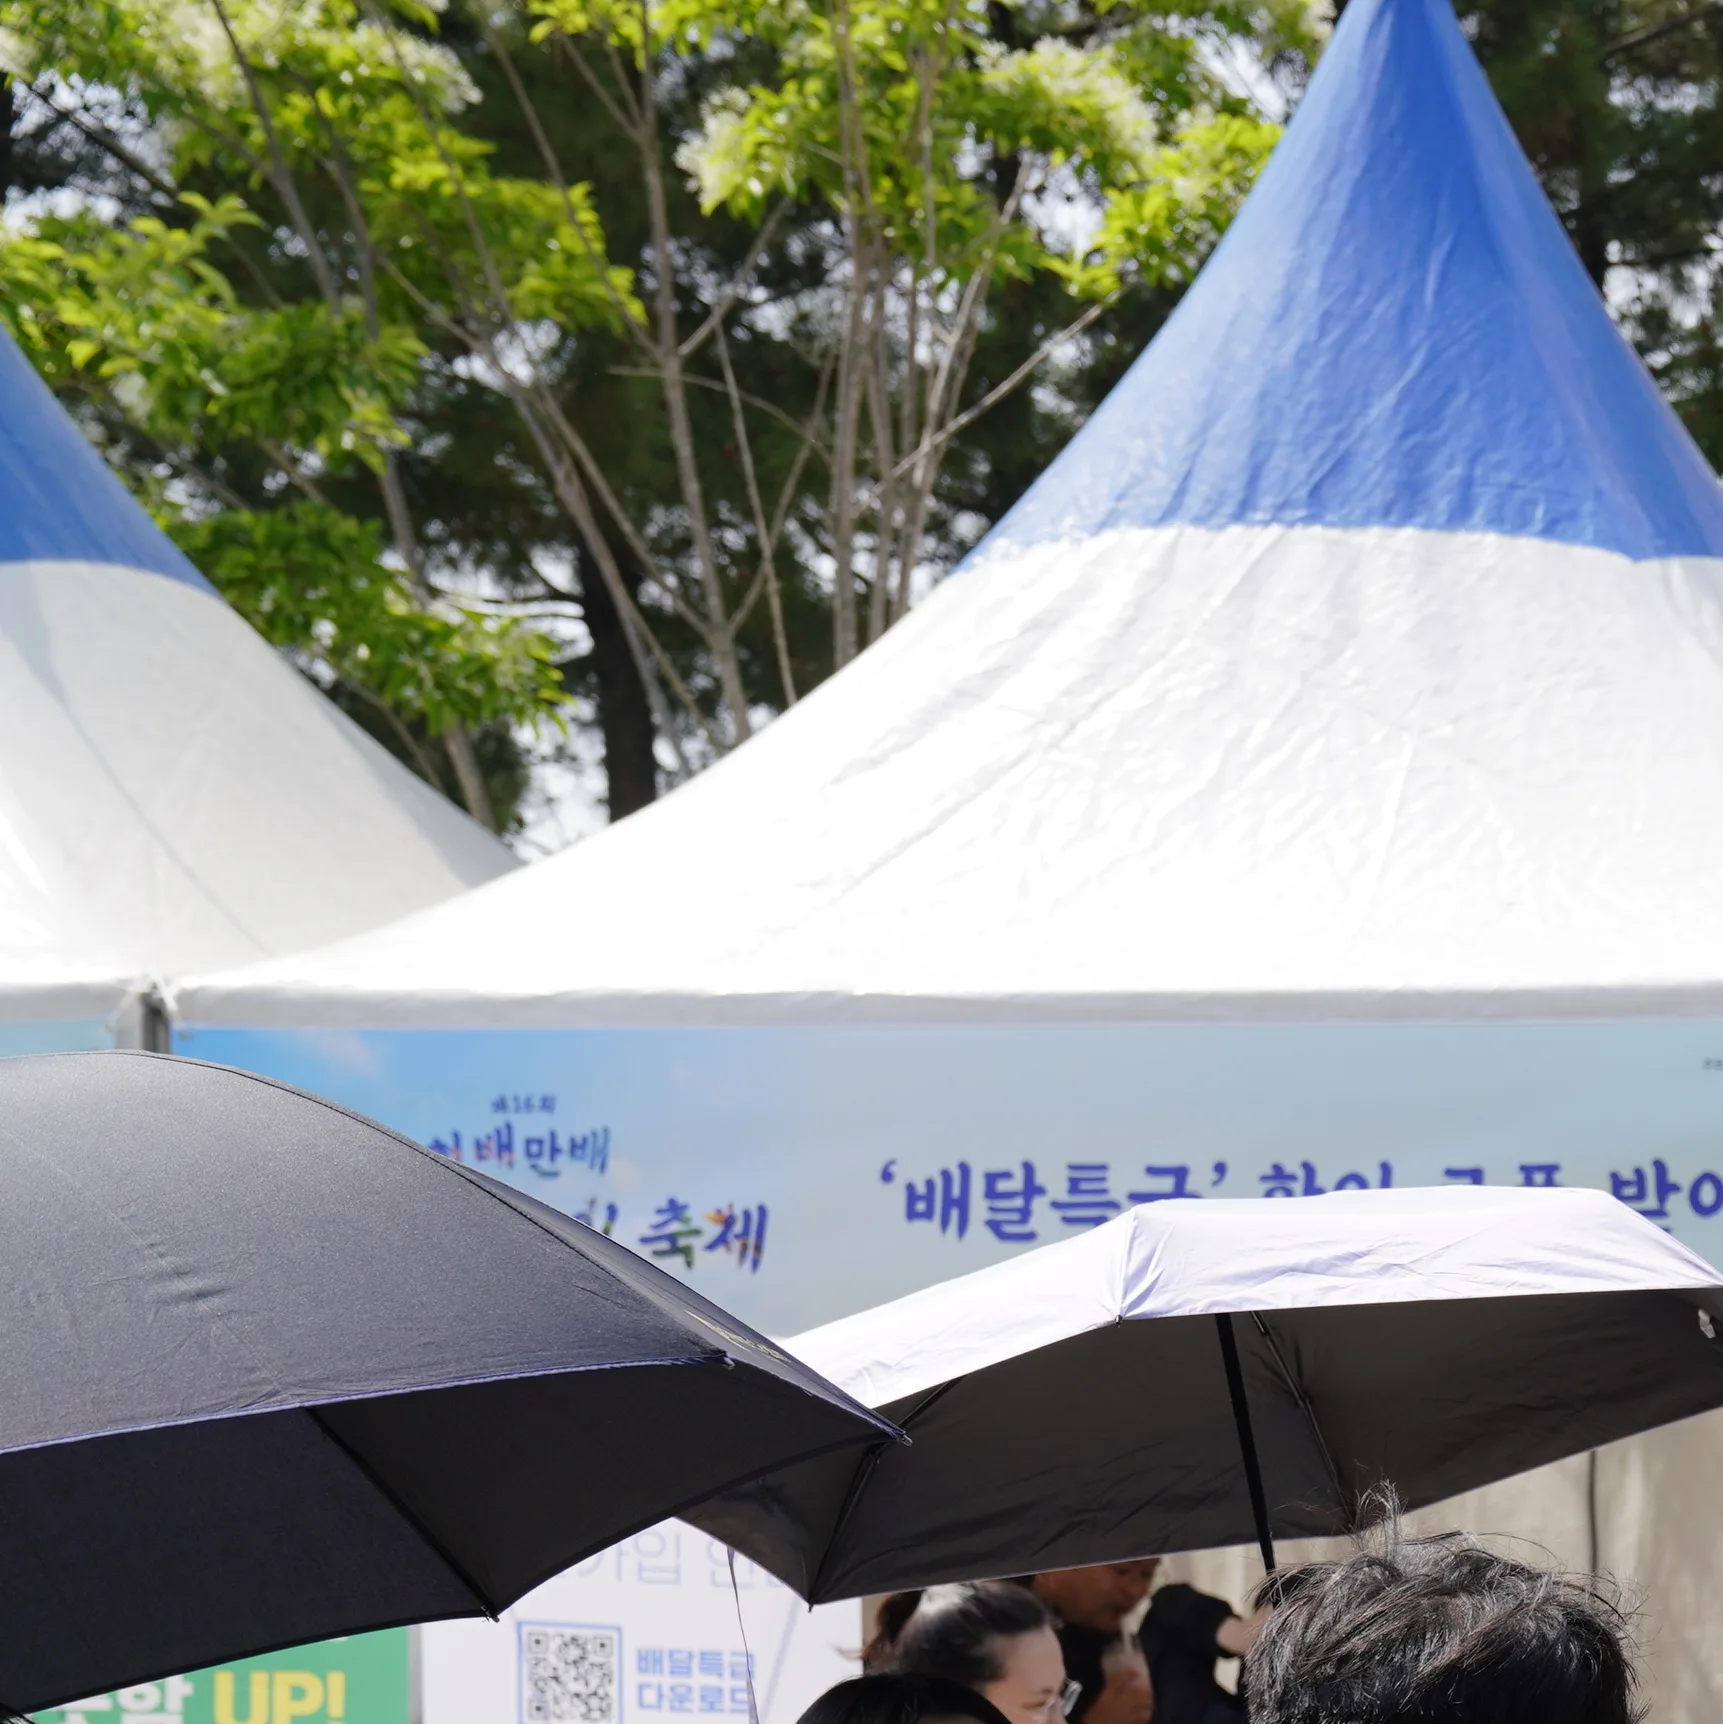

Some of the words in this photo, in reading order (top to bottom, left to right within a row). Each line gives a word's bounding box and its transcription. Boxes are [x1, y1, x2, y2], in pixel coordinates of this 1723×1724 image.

[638, 1198, 769, 1275] 축제
[636, 1647, 757, 1682] 배달특급
[636, 1683, 752, 1716] 다운로드
